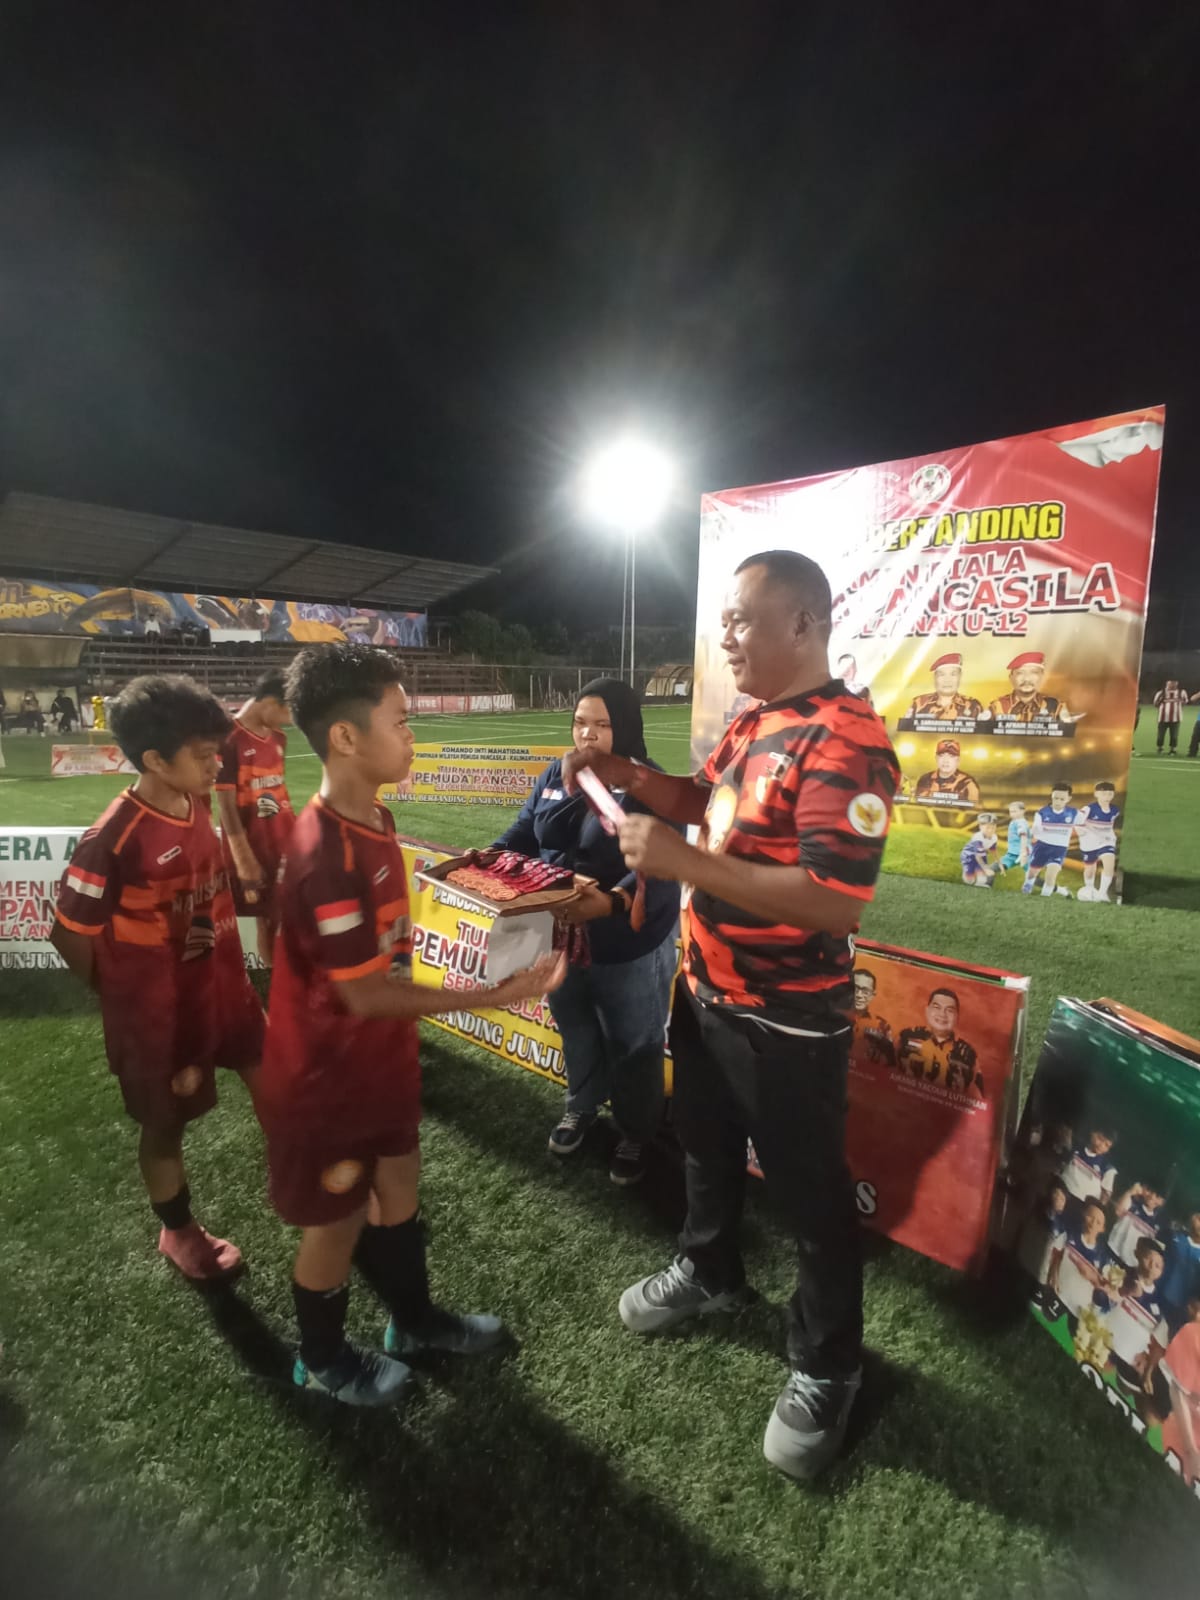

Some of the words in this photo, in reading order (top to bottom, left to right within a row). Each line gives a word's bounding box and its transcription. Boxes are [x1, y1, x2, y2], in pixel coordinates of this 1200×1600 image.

[966, 613, 1029, 635] U-12
[439, 766, 493, 775] TURNAMEN
[495, 768, 526, 776] PIALA
[415, 772, 468, 784] PEMUDA
